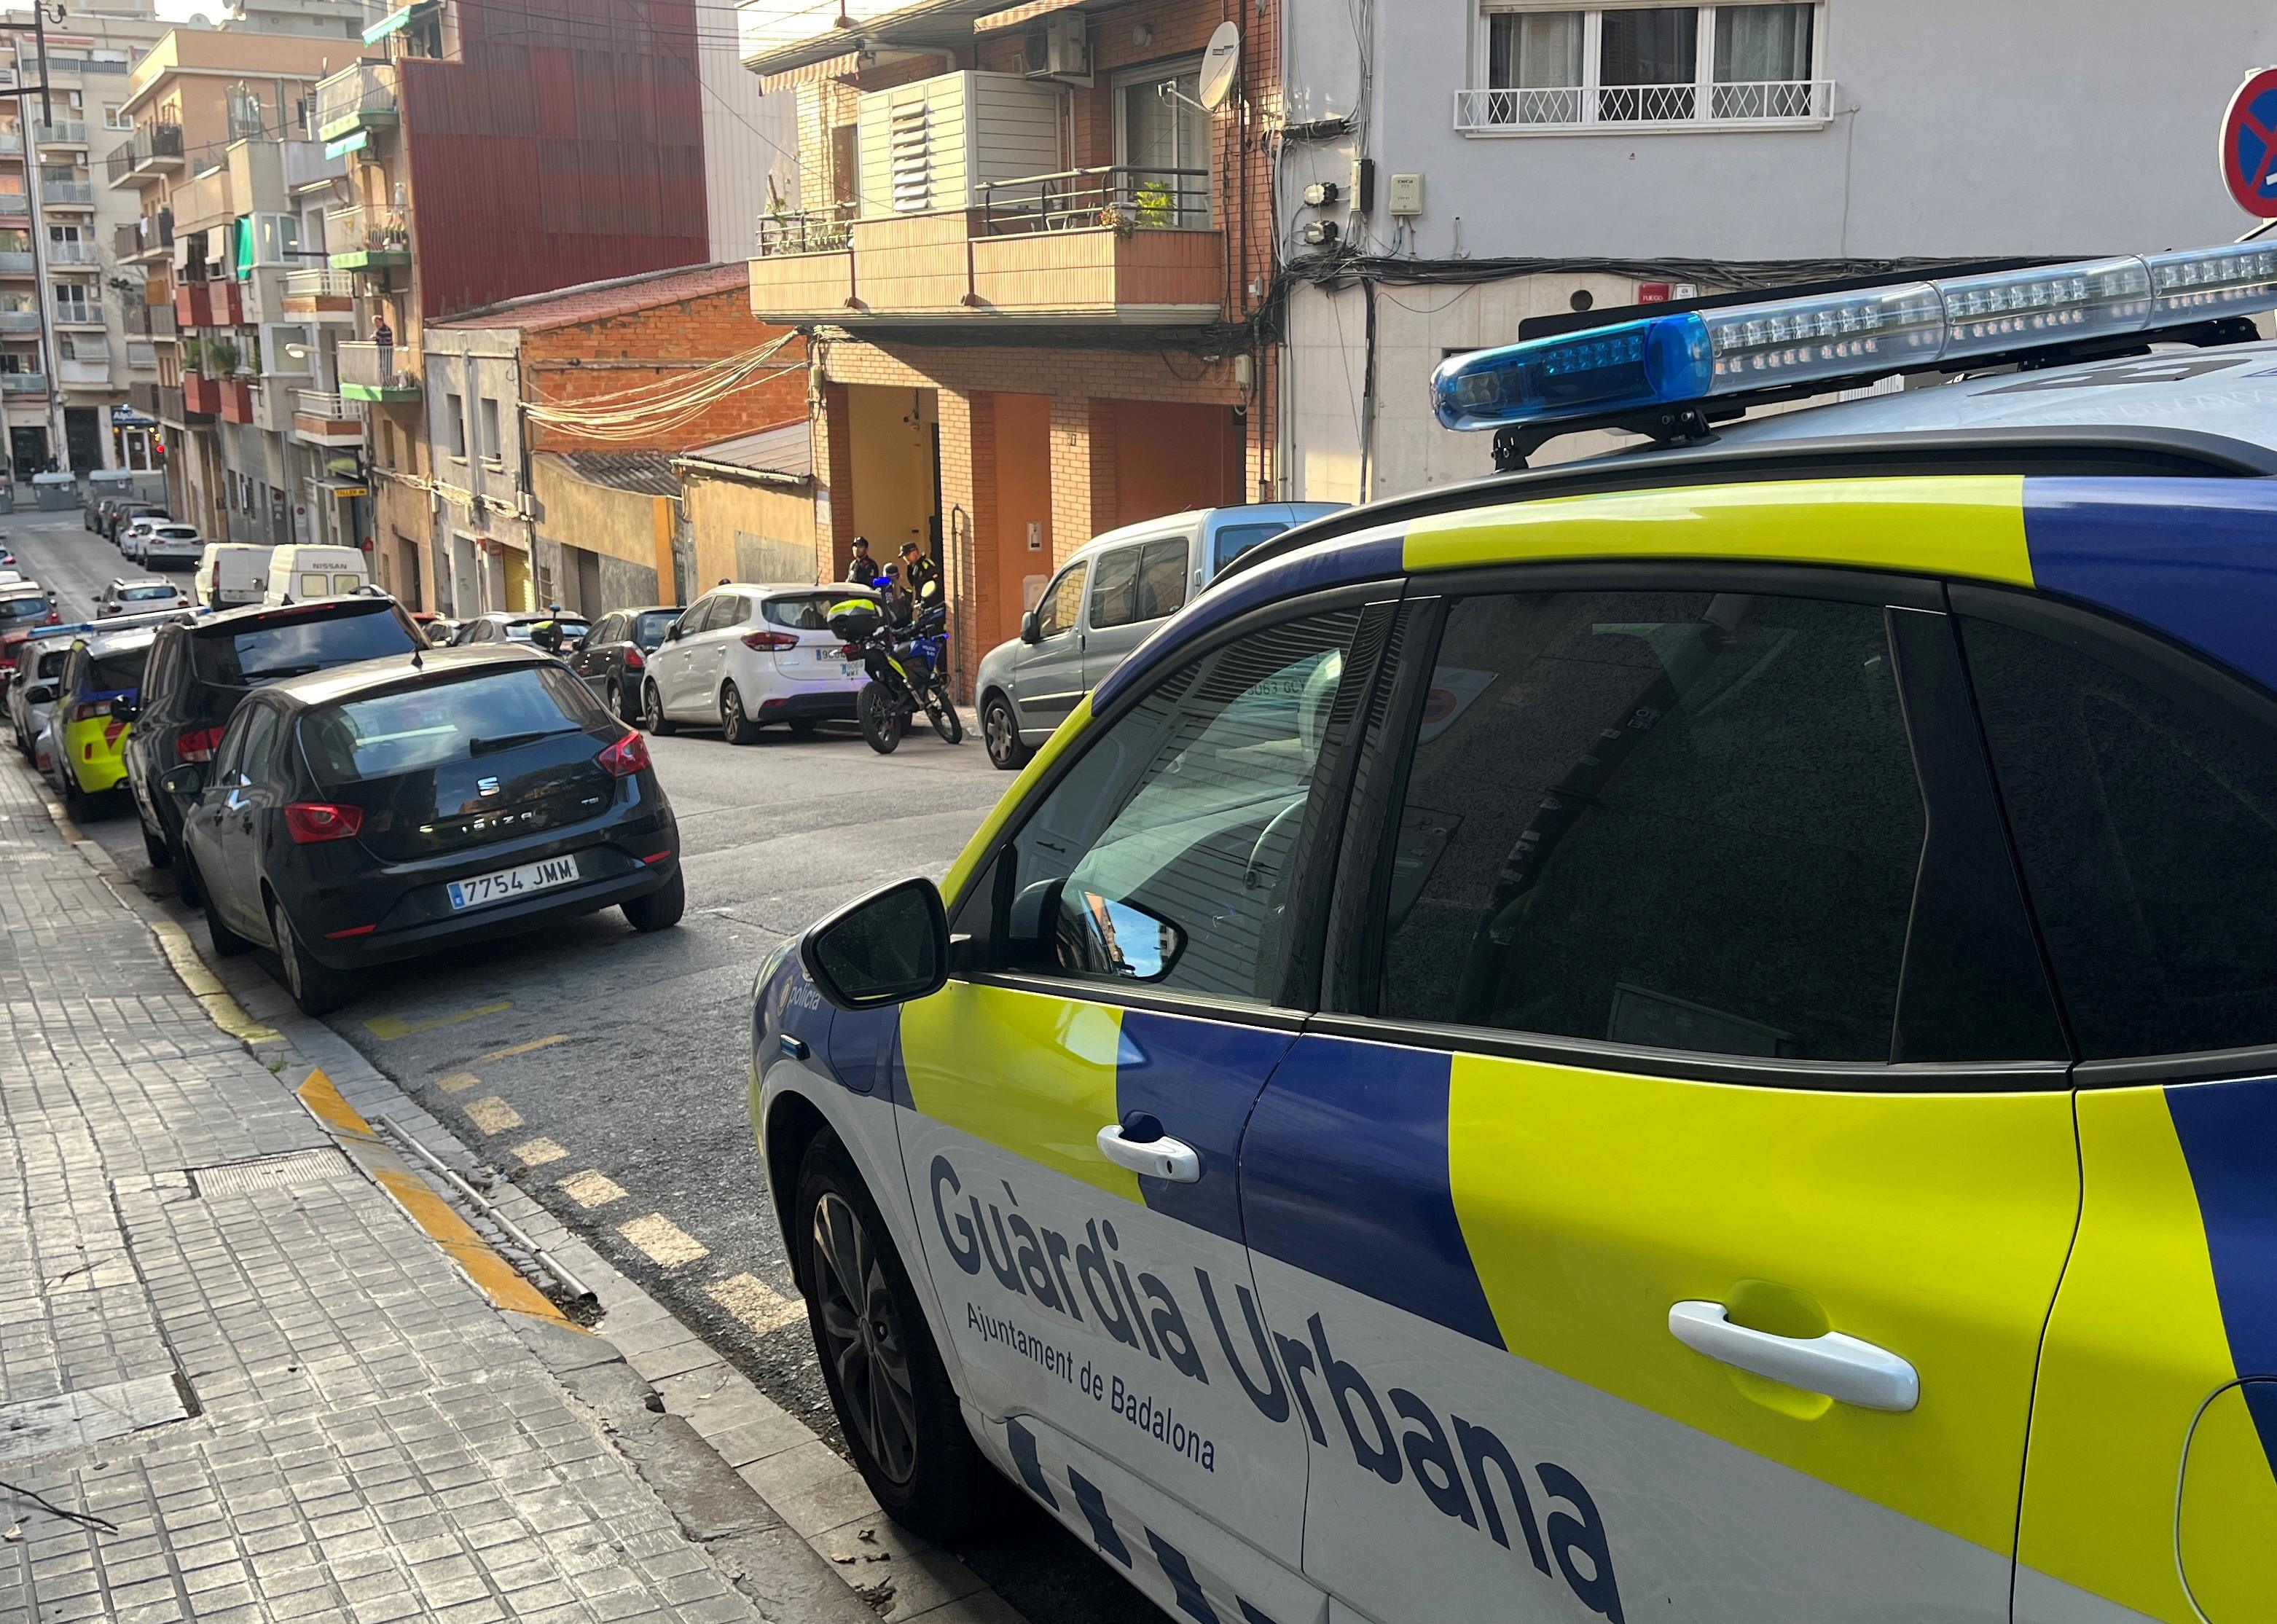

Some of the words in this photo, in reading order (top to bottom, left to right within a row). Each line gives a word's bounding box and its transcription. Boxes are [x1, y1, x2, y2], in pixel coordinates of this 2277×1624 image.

[461, 812, 533, 834] IBIZA
[464, 871, 524, 902] 7754
[533, 859, 573, 885] JMM
[930, 1155, 1210, 1386] Guàrdia
[1194, 1266, 1626, 1624] Urbana
[967, 1302, 1073, 1384] Ajuntament
[1080, 1360, 1103, 1400] de
[1111, 1375, 1215, 1472] Badalona
